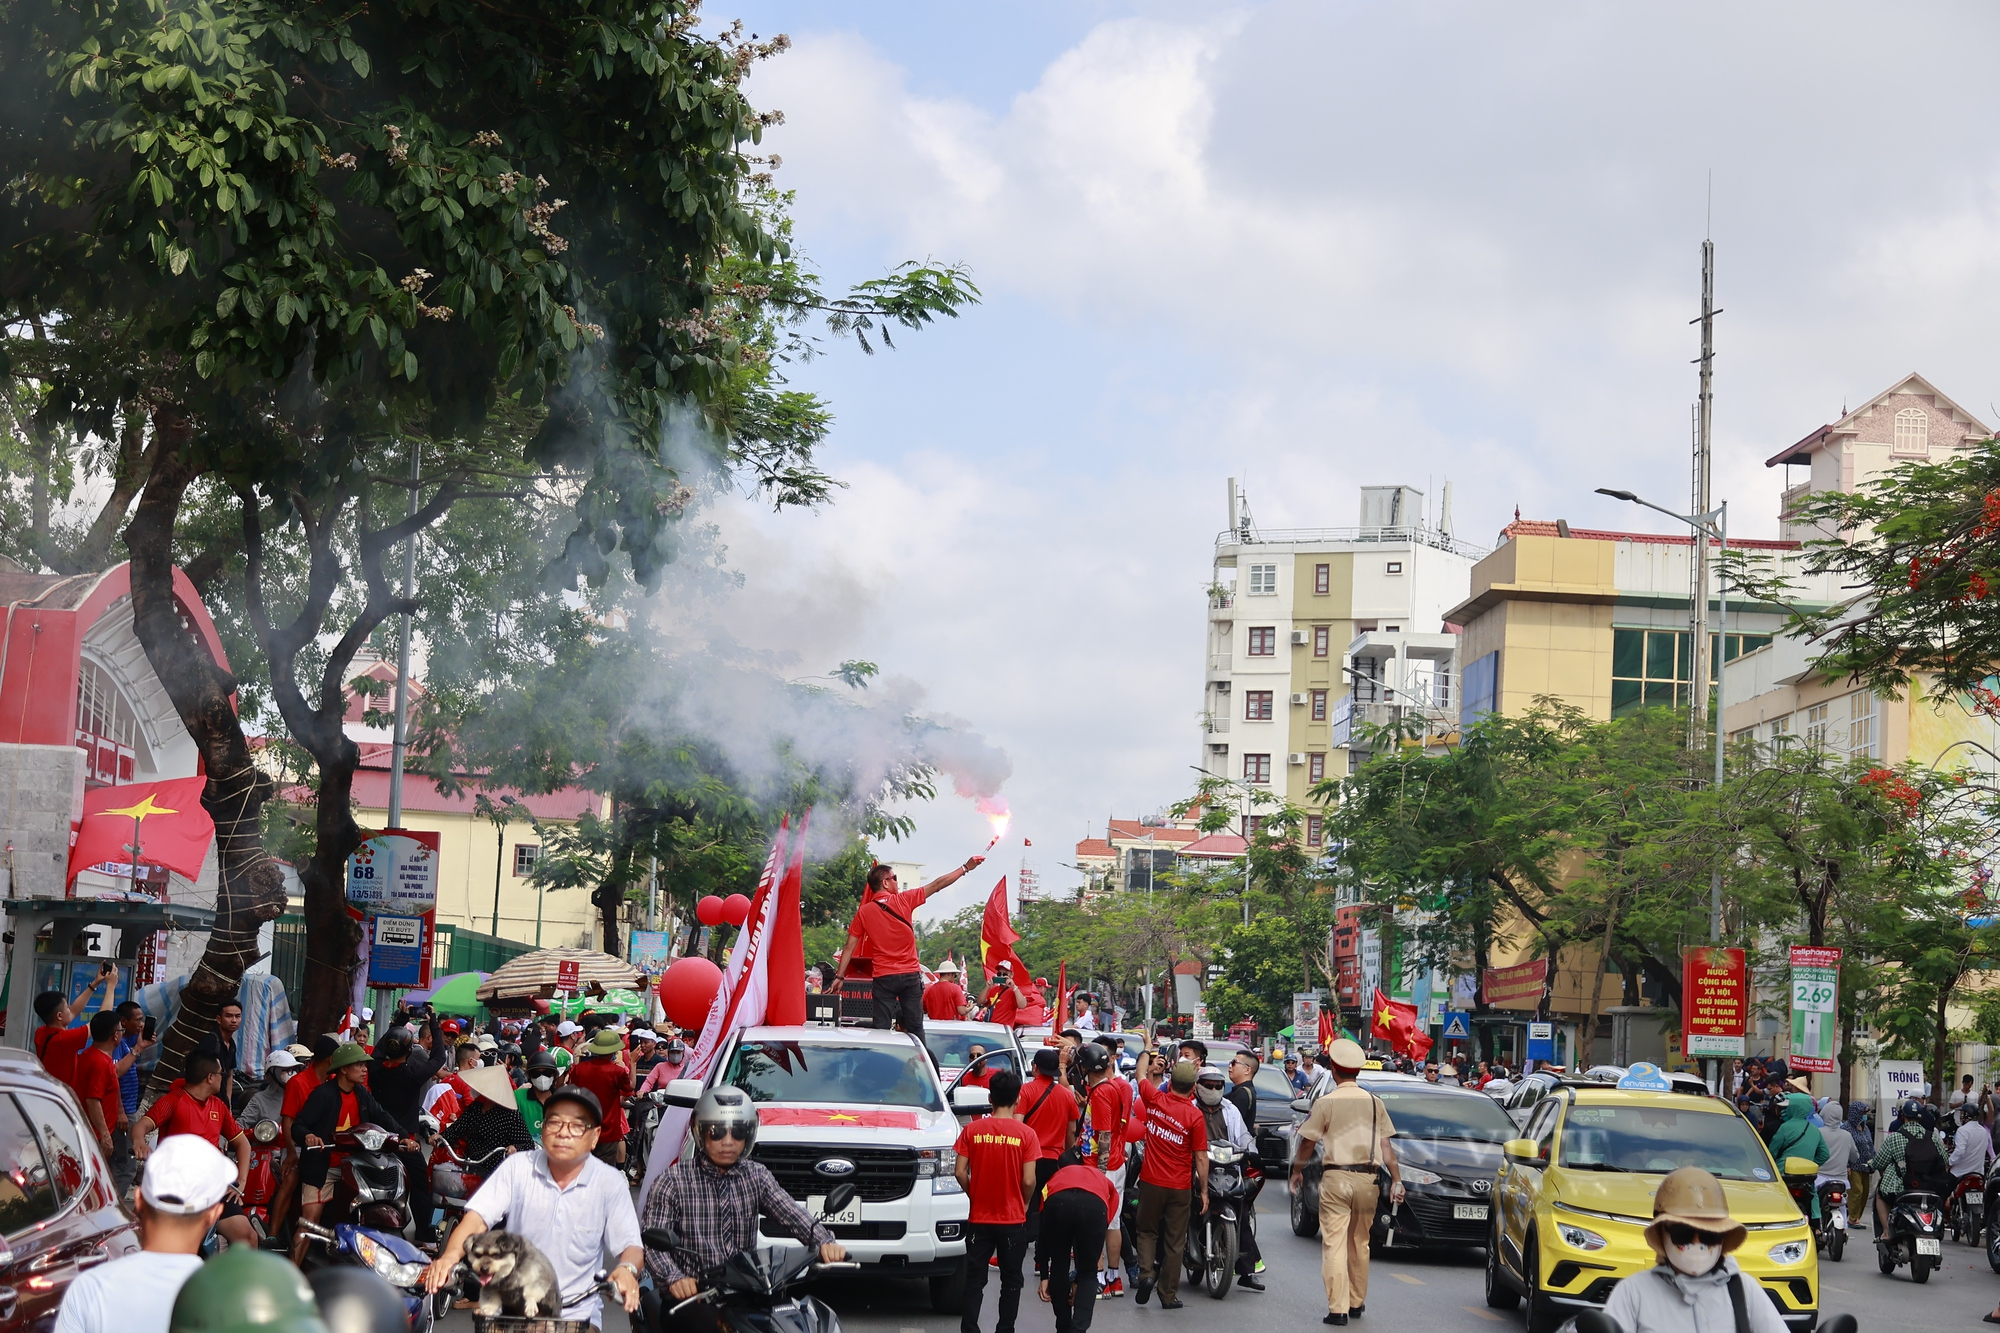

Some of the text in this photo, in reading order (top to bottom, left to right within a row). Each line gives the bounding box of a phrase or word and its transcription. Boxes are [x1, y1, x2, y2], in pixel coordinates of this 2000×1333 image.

[353, 866, 374, 880] 68
[1698, 977, 1719, 987] CỘNG
[1822, 974, 1836, 982] LITE
[1717, 987, 1731, 997] HỘI
[1797, 985, 1832, 1004] 2.69
[1699, 1007, 1736, 1016] VIỆT NAM
[1692, 1017, 1716, 1025] MUÔN
[1718, 1017, 1737, 1026] NĂM
[1887, 1069, 1920, 1083] TRÔNG
[994, 1133, 1006, 1146] VIỆT
[1006, 1135, 1021, 1147] NAM
[1156, 1126, 1184, 1145] PHÒNG
[824, 1162, 846, 1173] Ford
